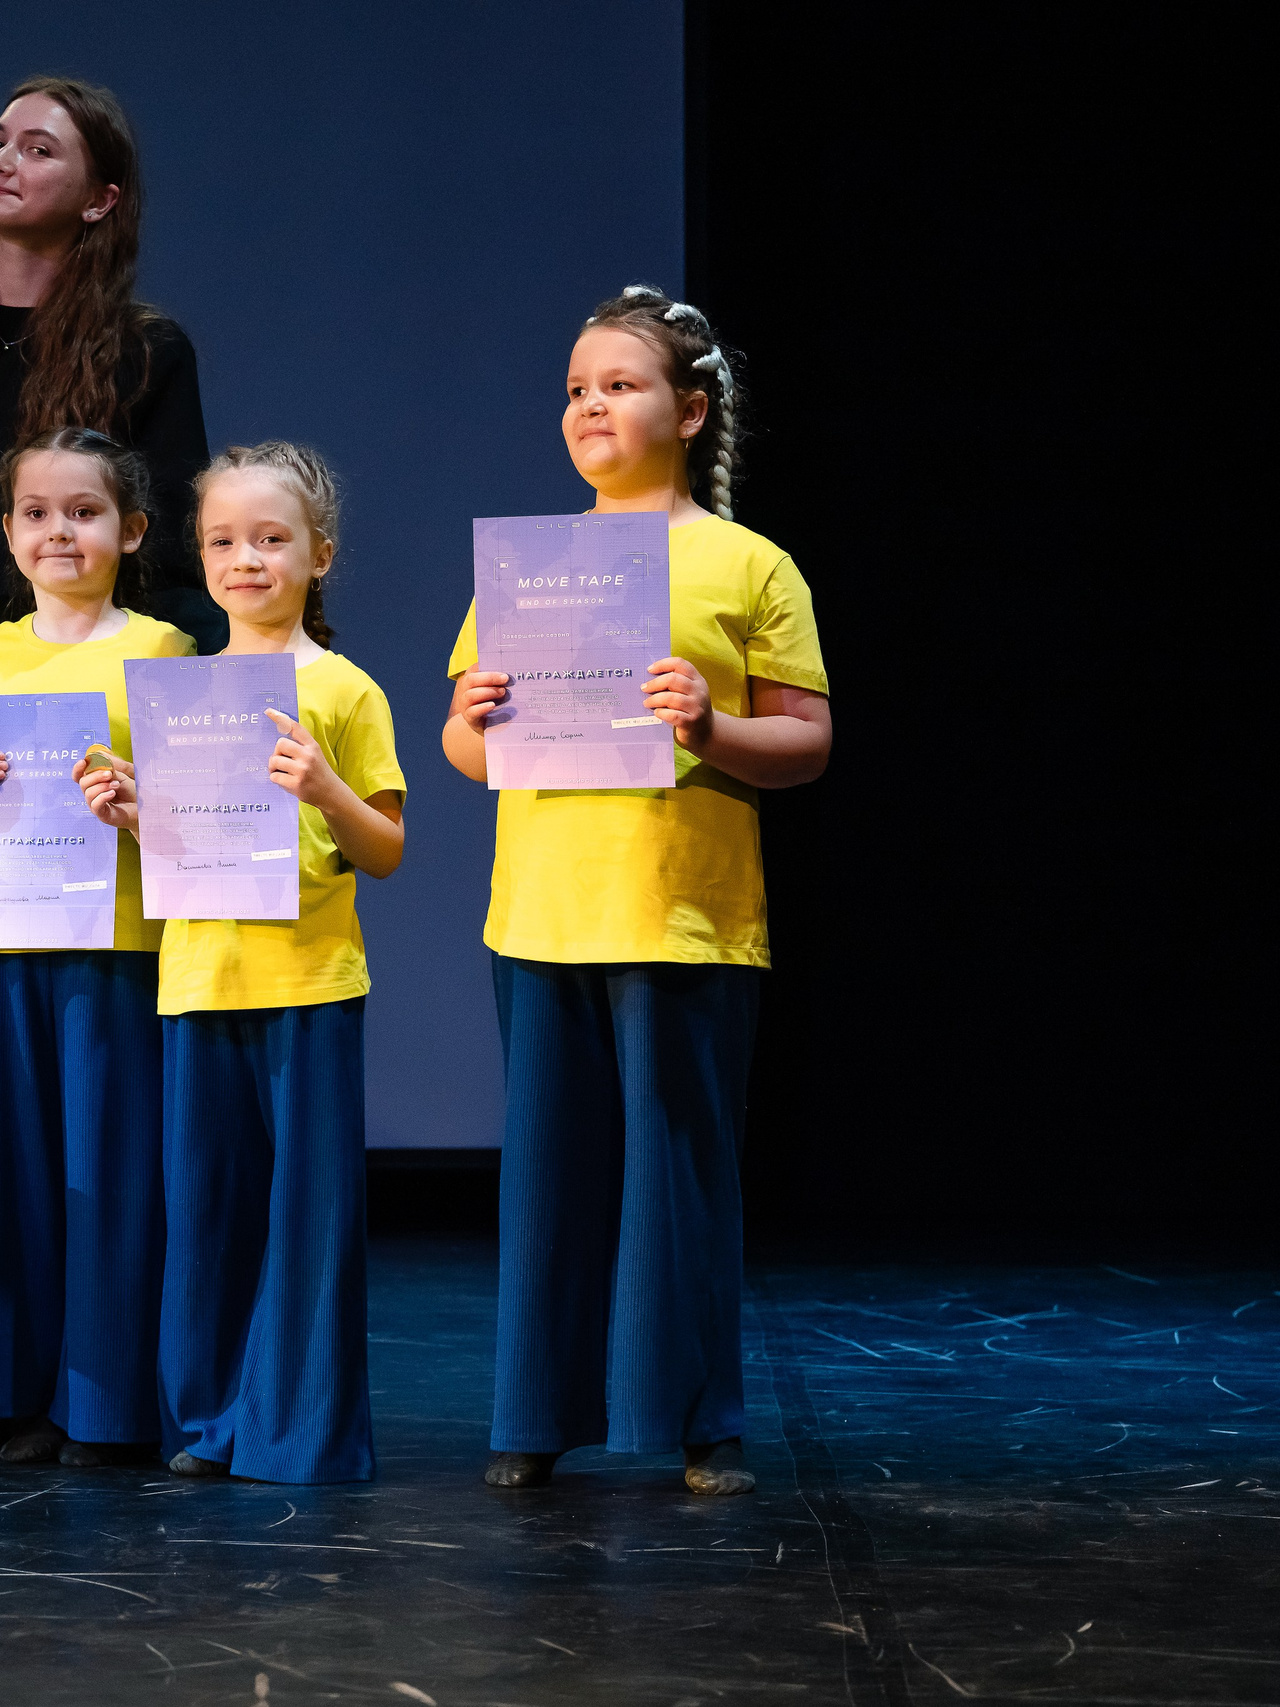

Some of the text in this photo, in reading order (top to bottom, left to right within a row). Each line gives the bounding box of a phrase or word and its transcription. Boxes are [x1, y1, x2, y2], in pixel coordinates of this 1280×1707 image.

[517, 574, 625, 589] MOVE TAPE
[519, 597, 605, 606] END OF SEASON
[515, 668, 633, 681] НАГРАЖДАЕТСЯ
[167, 713, 259, 727] MOVE TAPE
[4, 749, 79, 762] OVE TAPE
[29, 770, 64, 778] SEASON
[170, 803, 271, 814] НАГРАЖДАЕТСЯ
